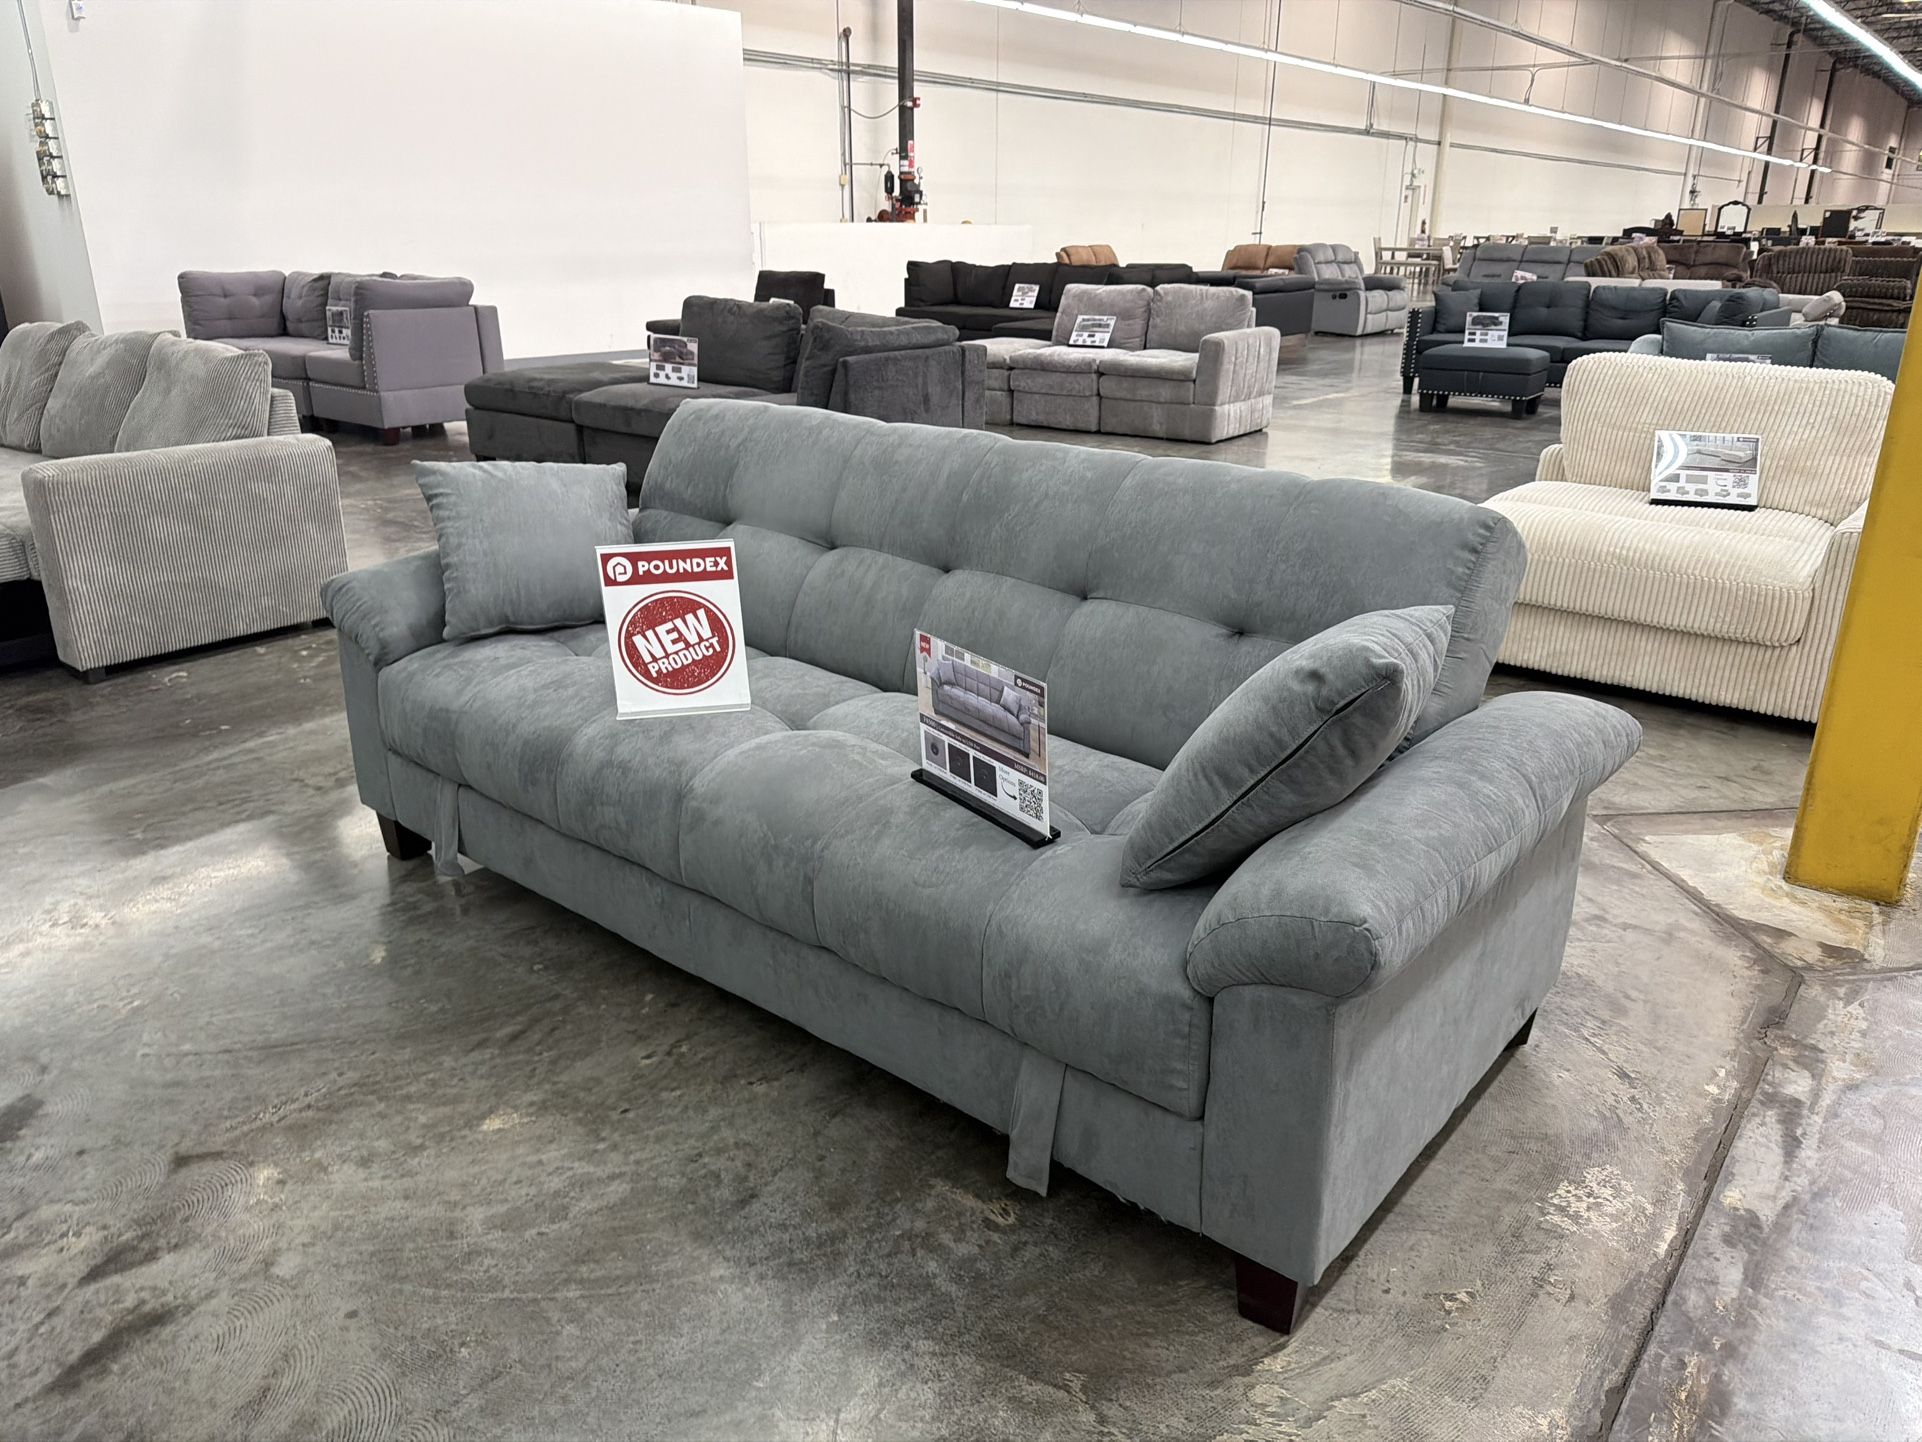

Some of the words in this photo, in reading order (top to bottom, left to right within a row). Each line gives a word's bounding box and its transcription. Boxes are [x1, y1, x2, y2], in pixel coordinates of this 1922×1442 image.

[637, 556, 729, 575] POUNDEX
[631, 608, 713, 664] NEW
[647, 636, 722, 678] PRODUCT
